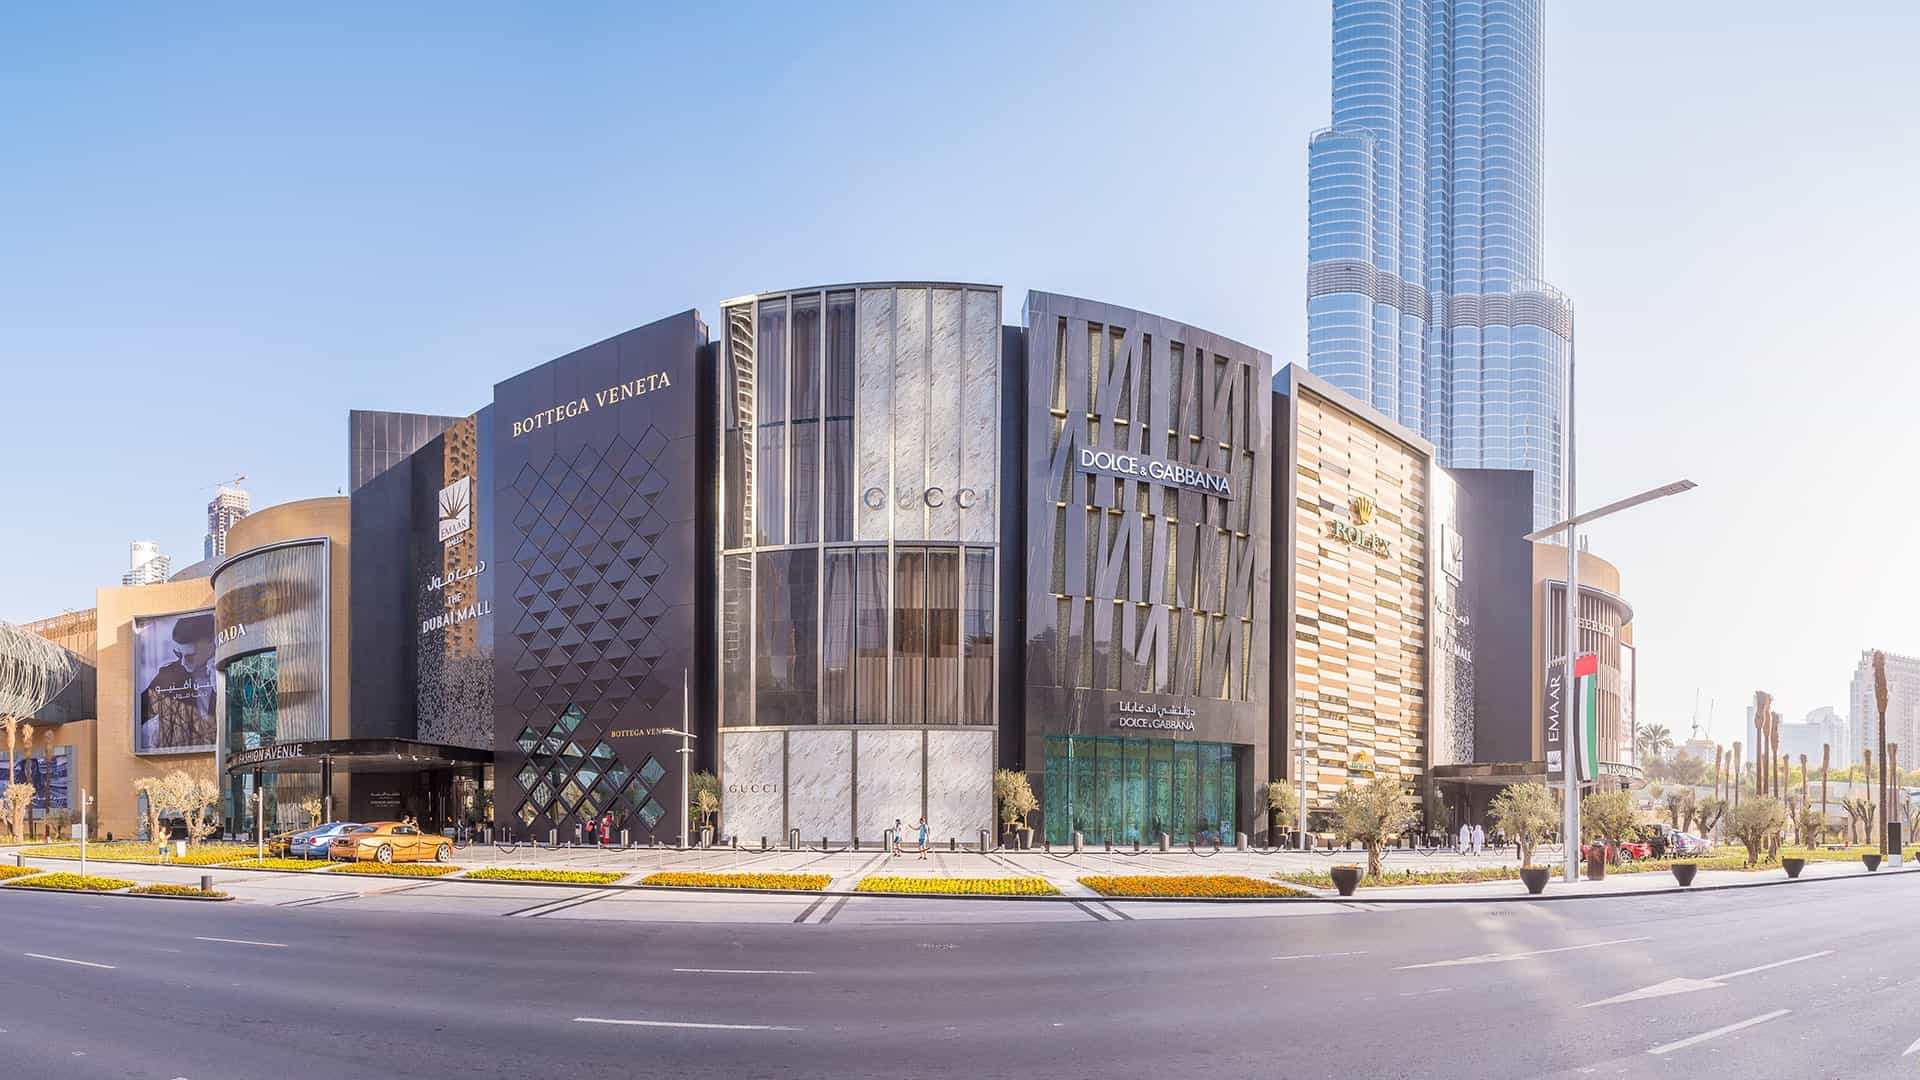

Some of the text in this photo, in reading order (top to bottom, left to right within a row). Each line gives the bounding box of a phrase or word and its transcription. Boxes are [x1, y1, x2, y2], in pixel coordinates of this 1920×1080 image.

[512, 370, 672, 438] BOTTEGA VENETA
[1081, 449, 1231, 494] DOLCE & GABBANA
[863, 486, 991, 511] GUCCI
[440, 519, 467, 539] EMAAR
[1332, 519, 1393, 559] ROLEX
[447, 592, 463, 605] THE
[422, 599, 491, 634] DUBAI MALL
[1549, 675, 1561, 742] EMAAR
[611, 728, 644, 738] BOTTEGA
[1119, 718, 1148, 728] DOLCE
[1152, 719, 1195, 731] GABBANA
[265, 743, 303, 760] AVENUE
[729, 784, 777, 793] GUCCI
